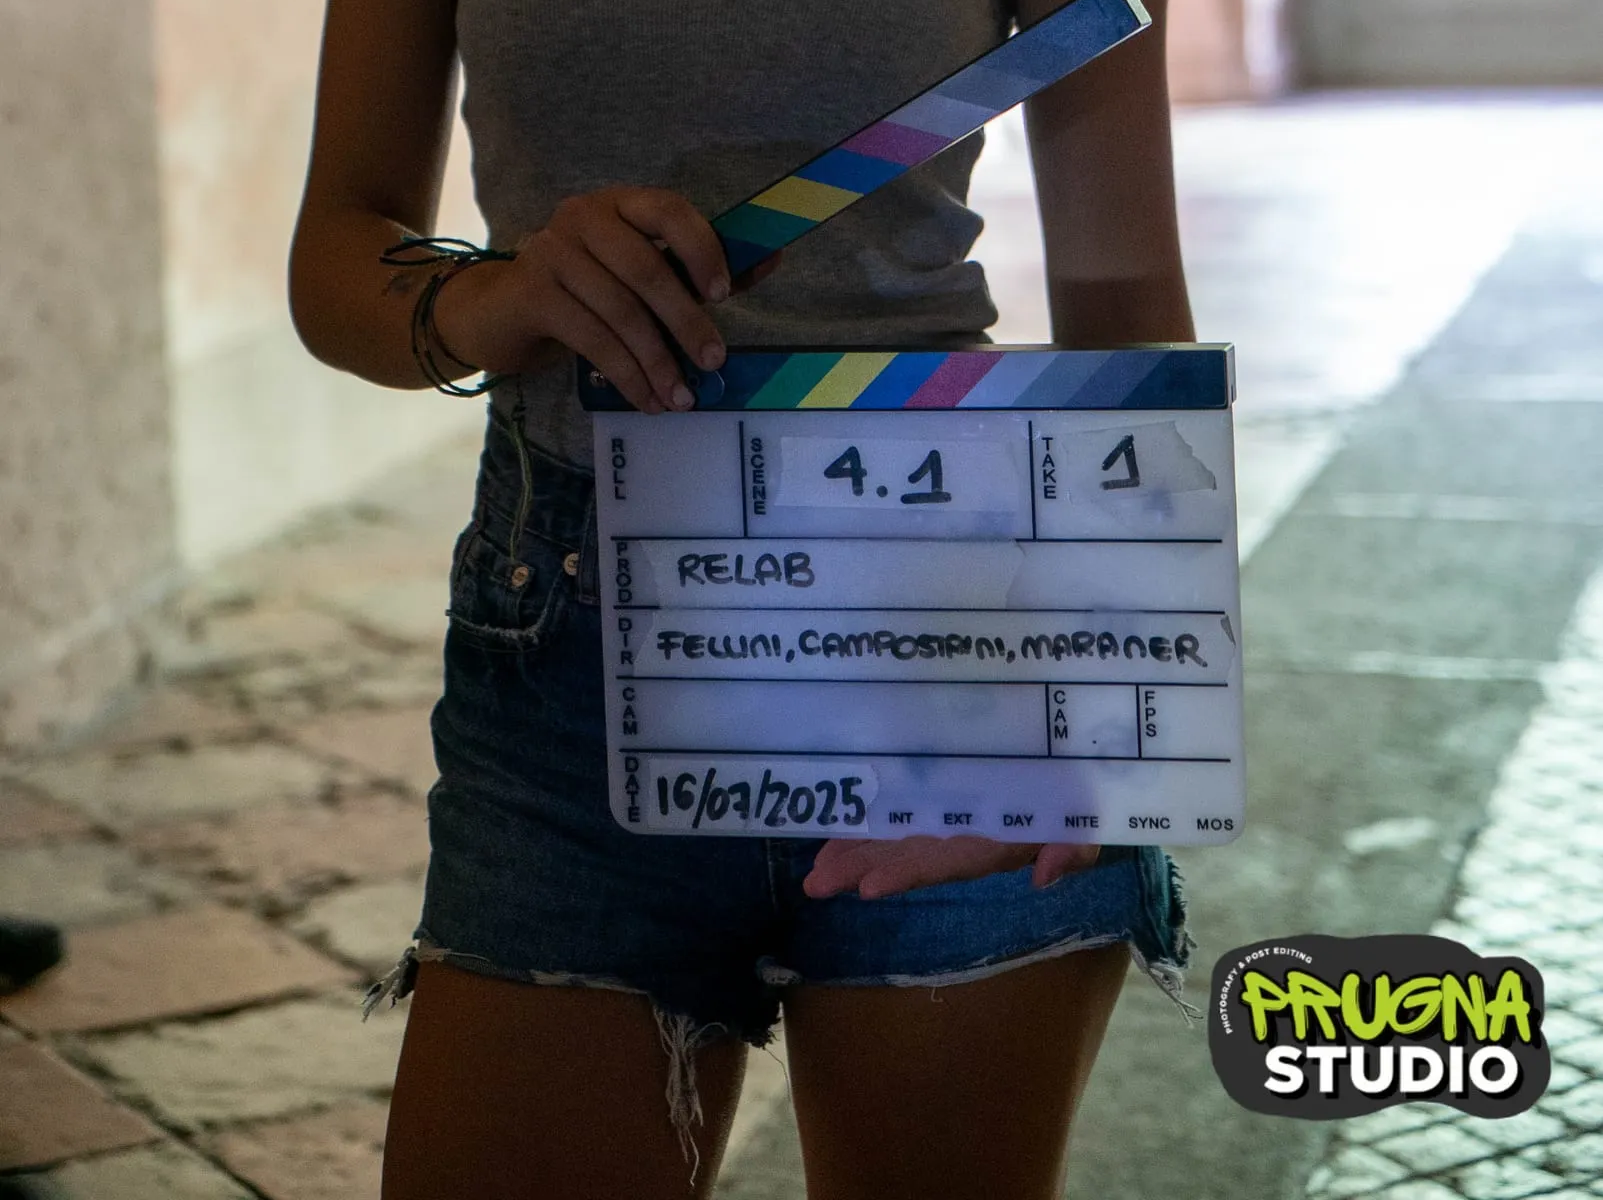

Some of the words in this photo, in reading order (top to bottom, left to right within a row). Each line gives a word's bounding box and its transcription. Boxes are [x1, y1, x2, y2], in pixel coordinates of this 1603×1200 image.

[611, 437, 626, 501] ROLL
[751, 437, 767, 516] SCENE
[823, 446, 953, 504] 4.1
[1041, 436, 1057, 500] TAKE
[1101, 434, 1140, 490] 1
[616, 542, 632, 604] PROD
[678, 551, 816, 589] RELAB
[617, 619, 633, 665] DIR
[621, 687, 639, 736] CAM
[1053, 690, 1069, 740] CAM
[1144, 690, 1157, 738] FPS
[625, 756, 641, 822] DATE
[657, 767, 866, 829] 16/07/2025
[888, 812, 913, 825] INT
[944, 813, 973, 826] EXT
[1003, 814, 1034, 827] DAY
[1064, 815, 1100, 829] NITE
[1128, 816, 1171, 830] SYNC
[1196, 818, 1234, 832] MOS
